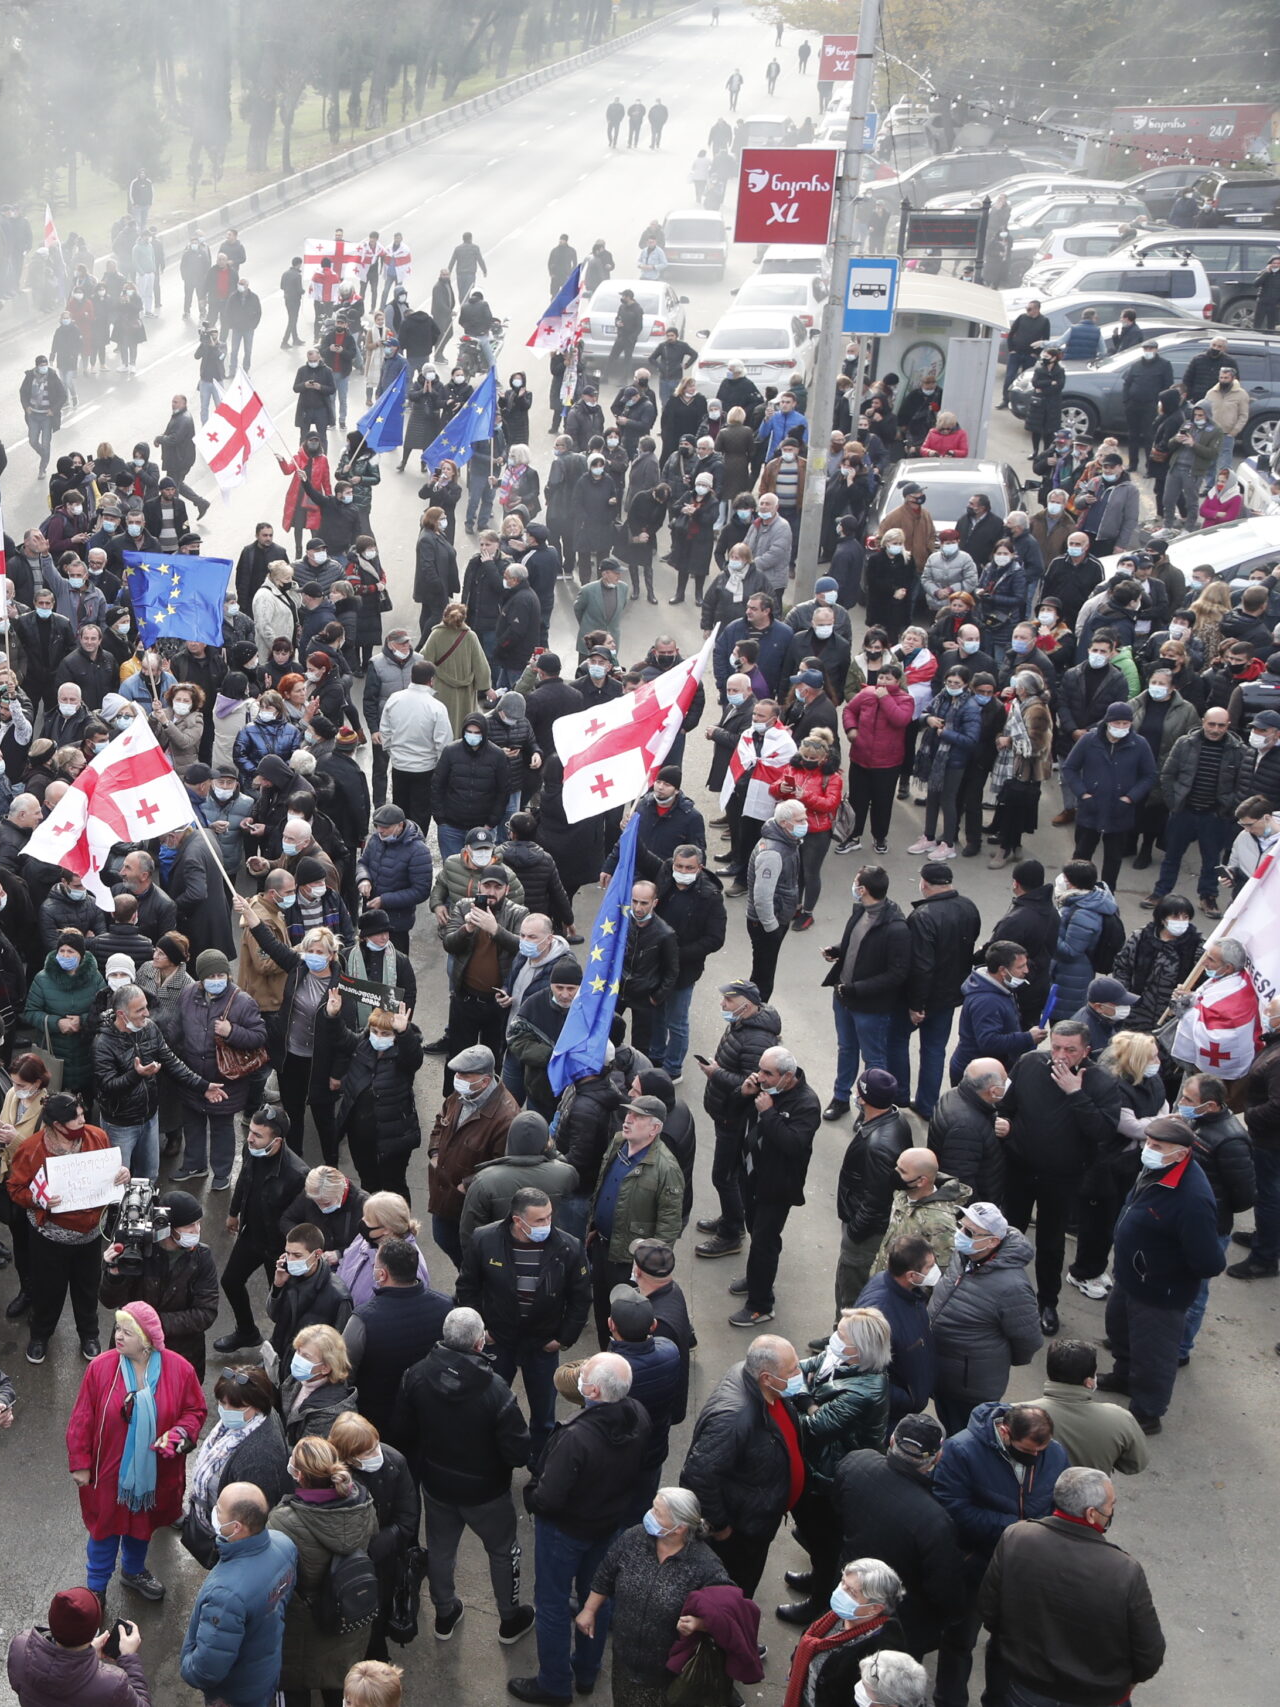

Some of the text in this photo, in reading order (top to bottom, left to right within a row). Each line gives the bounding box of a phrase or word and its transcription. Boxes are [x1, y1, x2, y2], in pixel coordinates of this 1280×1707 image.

[836, 47, 858, 59] ნიკო
[833, 60, 850, 72] XL
[1209, 125, 1234, 137] 24/7
[771, 173, 831, 199] ნიკორა
[766, 202, 800, 225] XL
